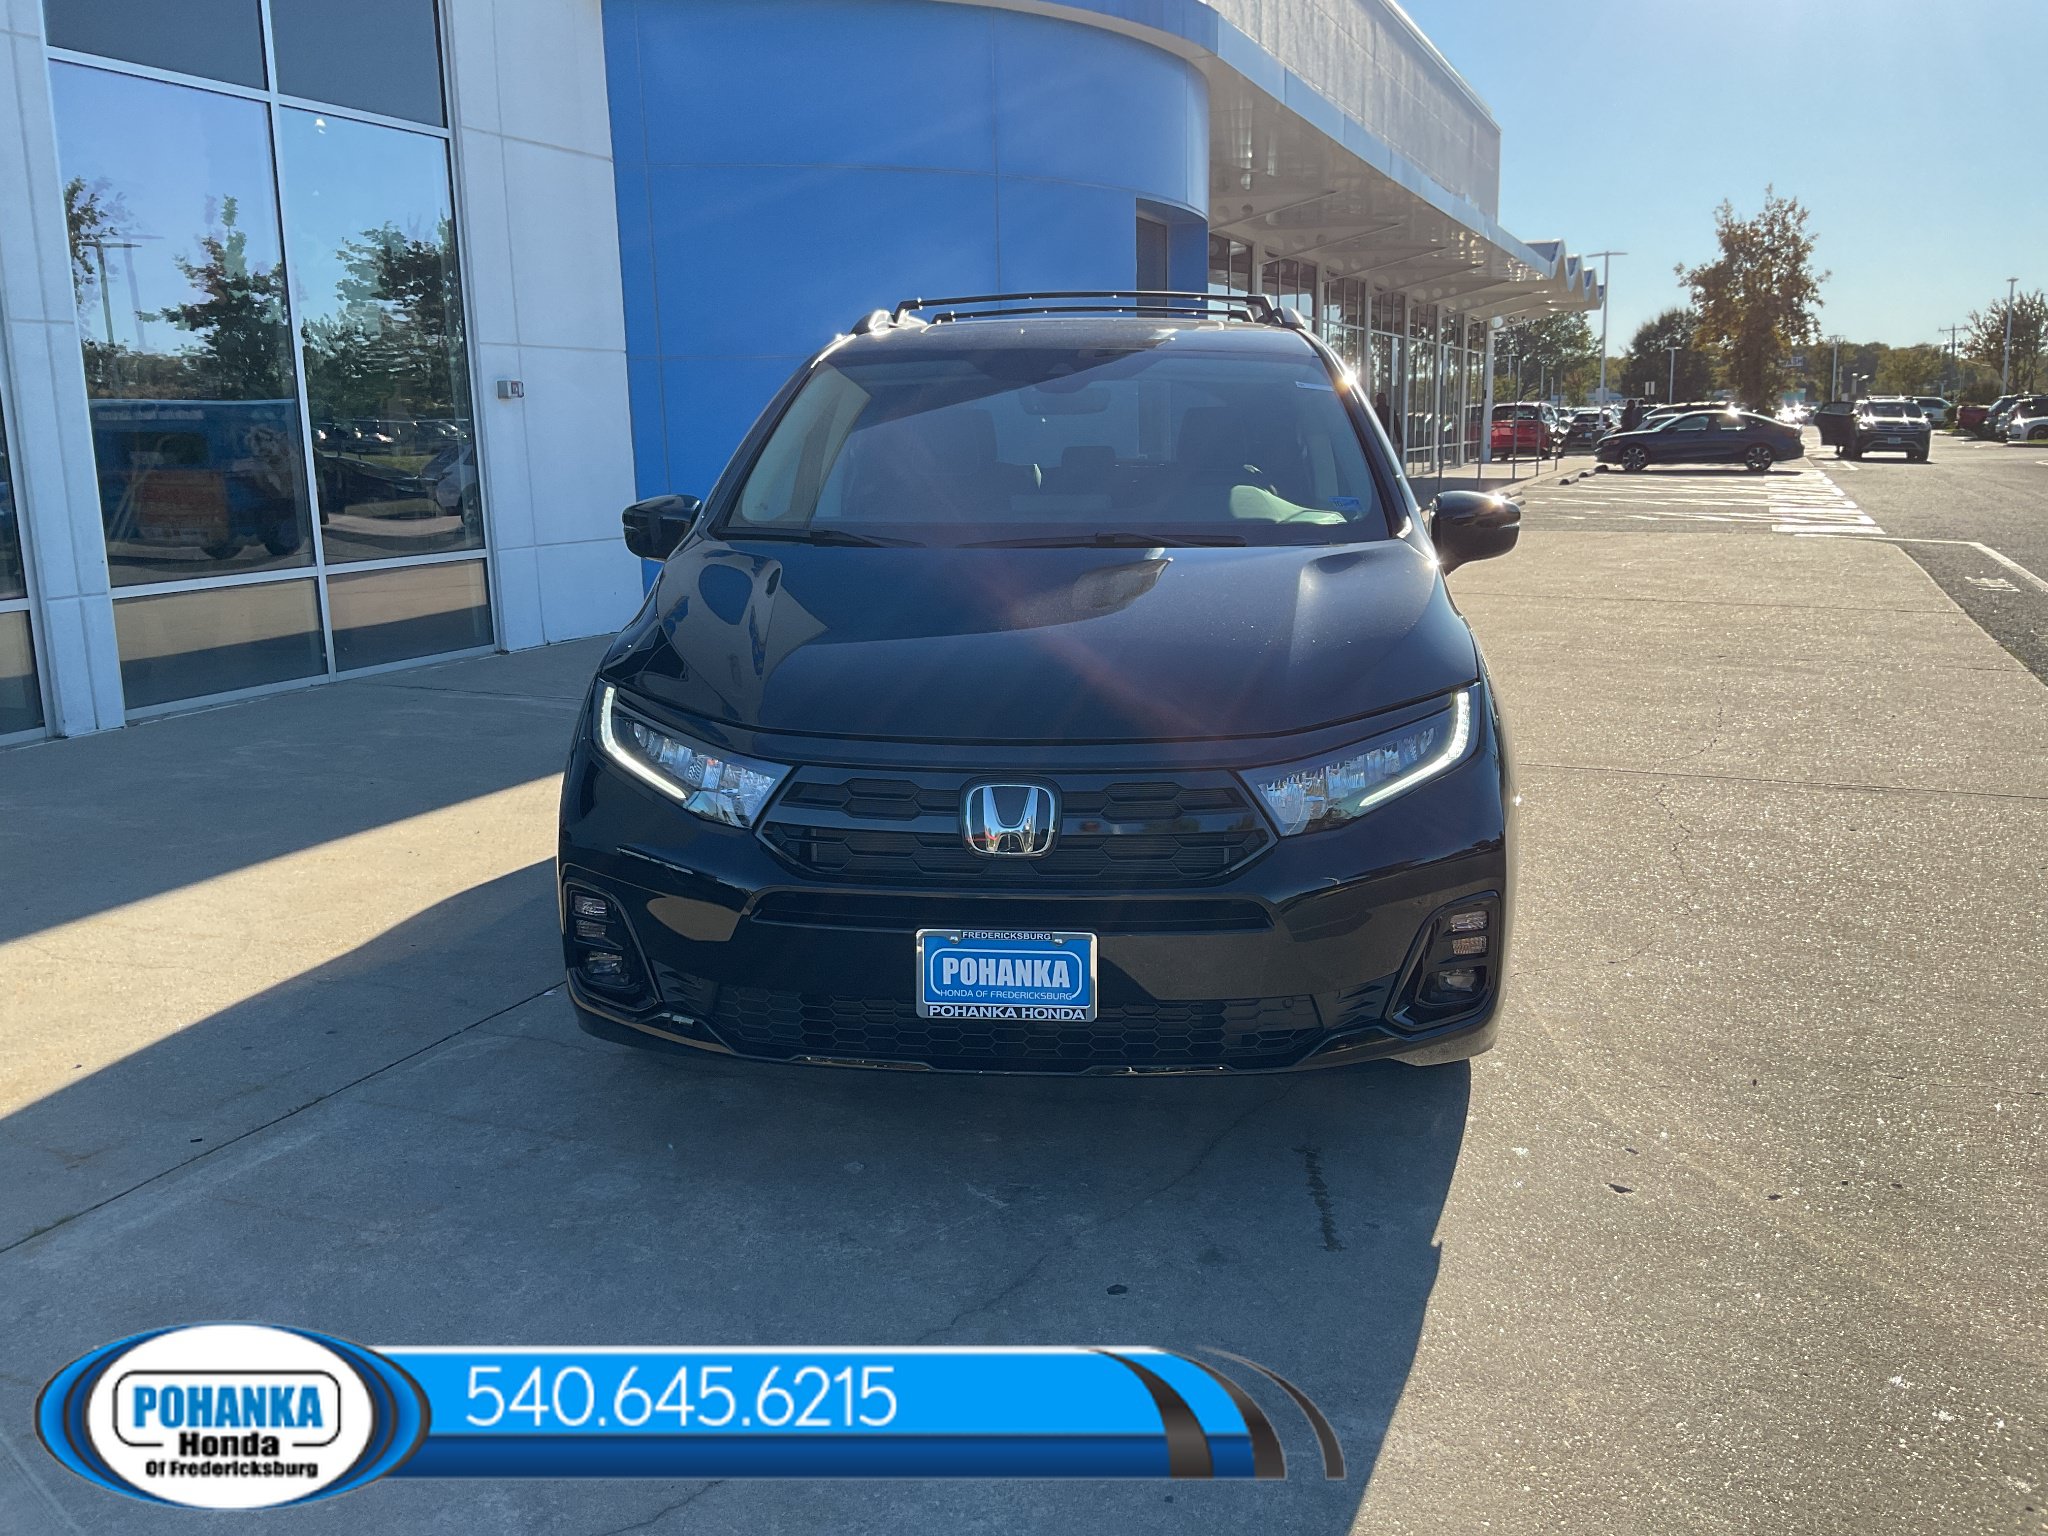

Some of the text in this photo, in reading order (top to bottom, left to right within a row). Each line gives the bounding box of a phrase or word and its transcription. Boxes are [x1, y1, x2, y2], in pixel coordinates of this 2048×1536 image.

[962, 931, 1051, 940] FREDERICKSBURG
[943, 957, 1070, 988] POHANKA
[940, 989, 1072, 1000] HONDA OF FREDERICKSBURG
[929, 1005, 1085, 1020] POHANKA HONDA
